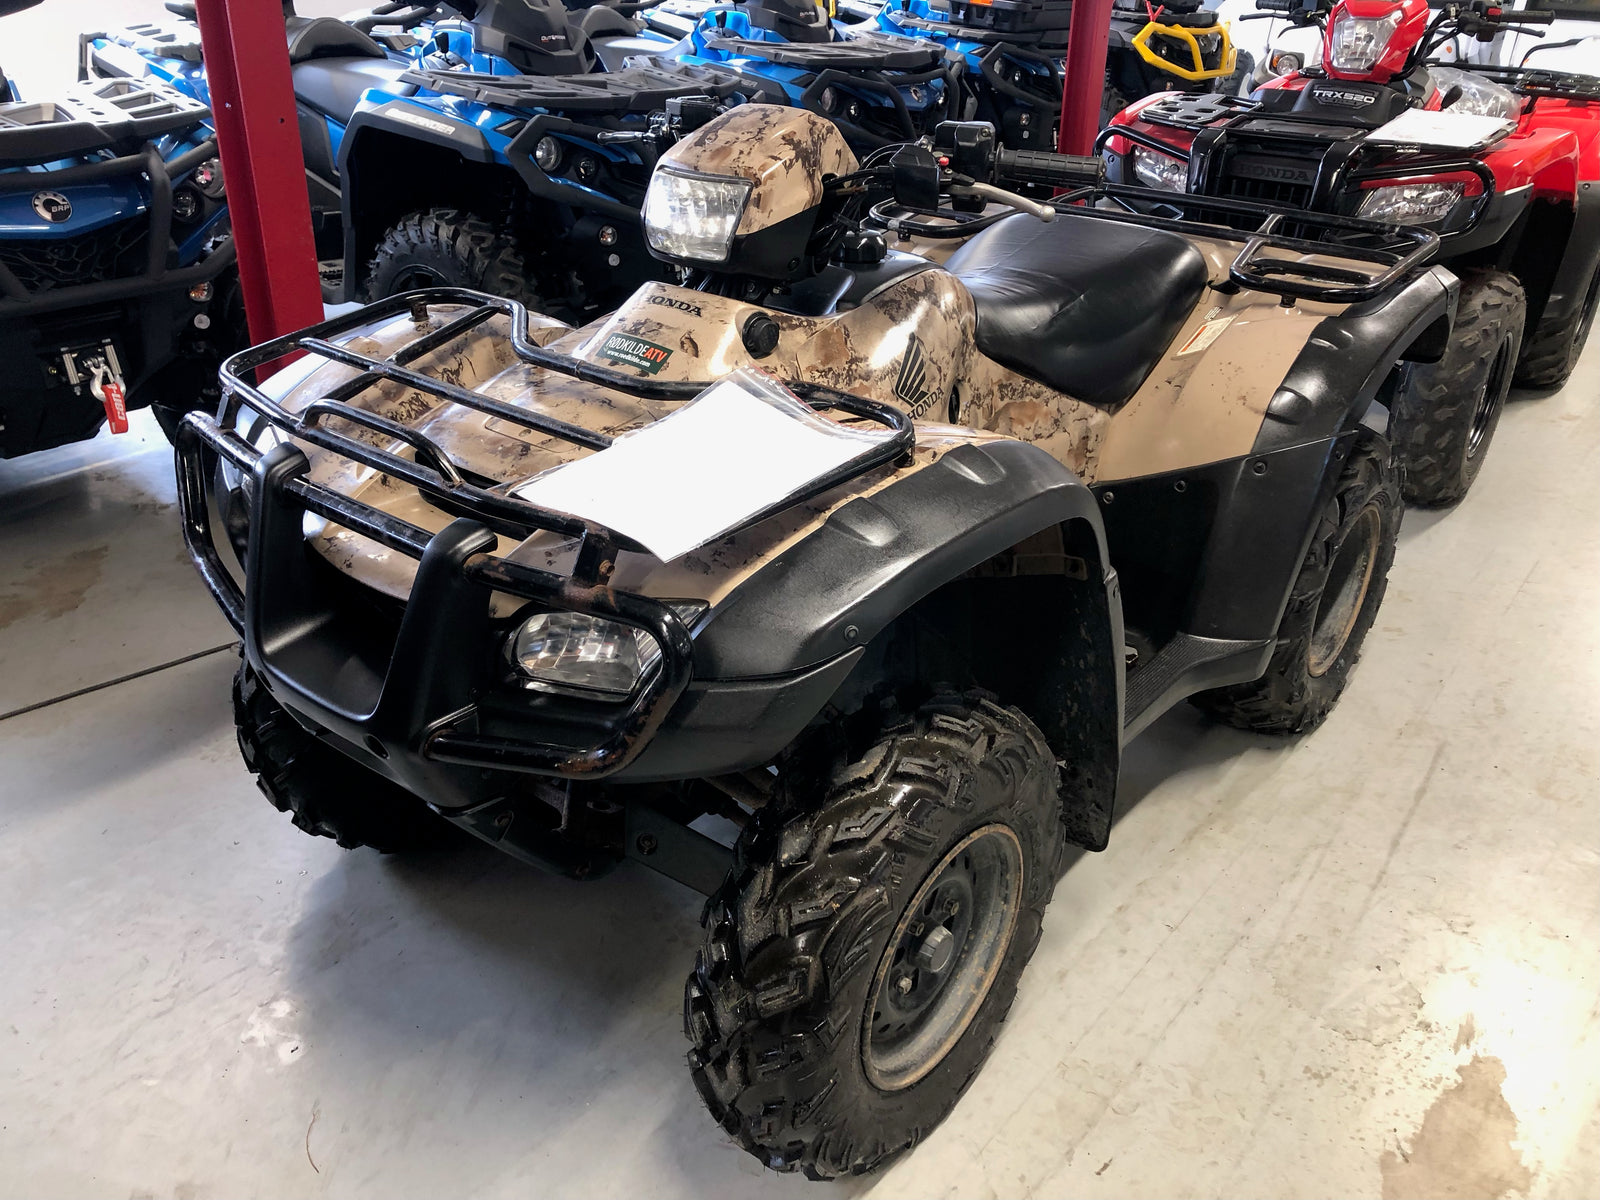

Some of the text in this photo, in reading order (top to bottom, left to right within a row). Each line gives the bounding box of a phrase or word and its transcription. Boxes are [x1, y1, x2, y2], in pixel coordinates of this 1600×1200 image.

[1312, 89, 1376, 104] TRX520
[1239, 163, 1311, 182] HONDA
[51, 204, 70, 213] BRP
[906, 386, 945, 420] HONDA
